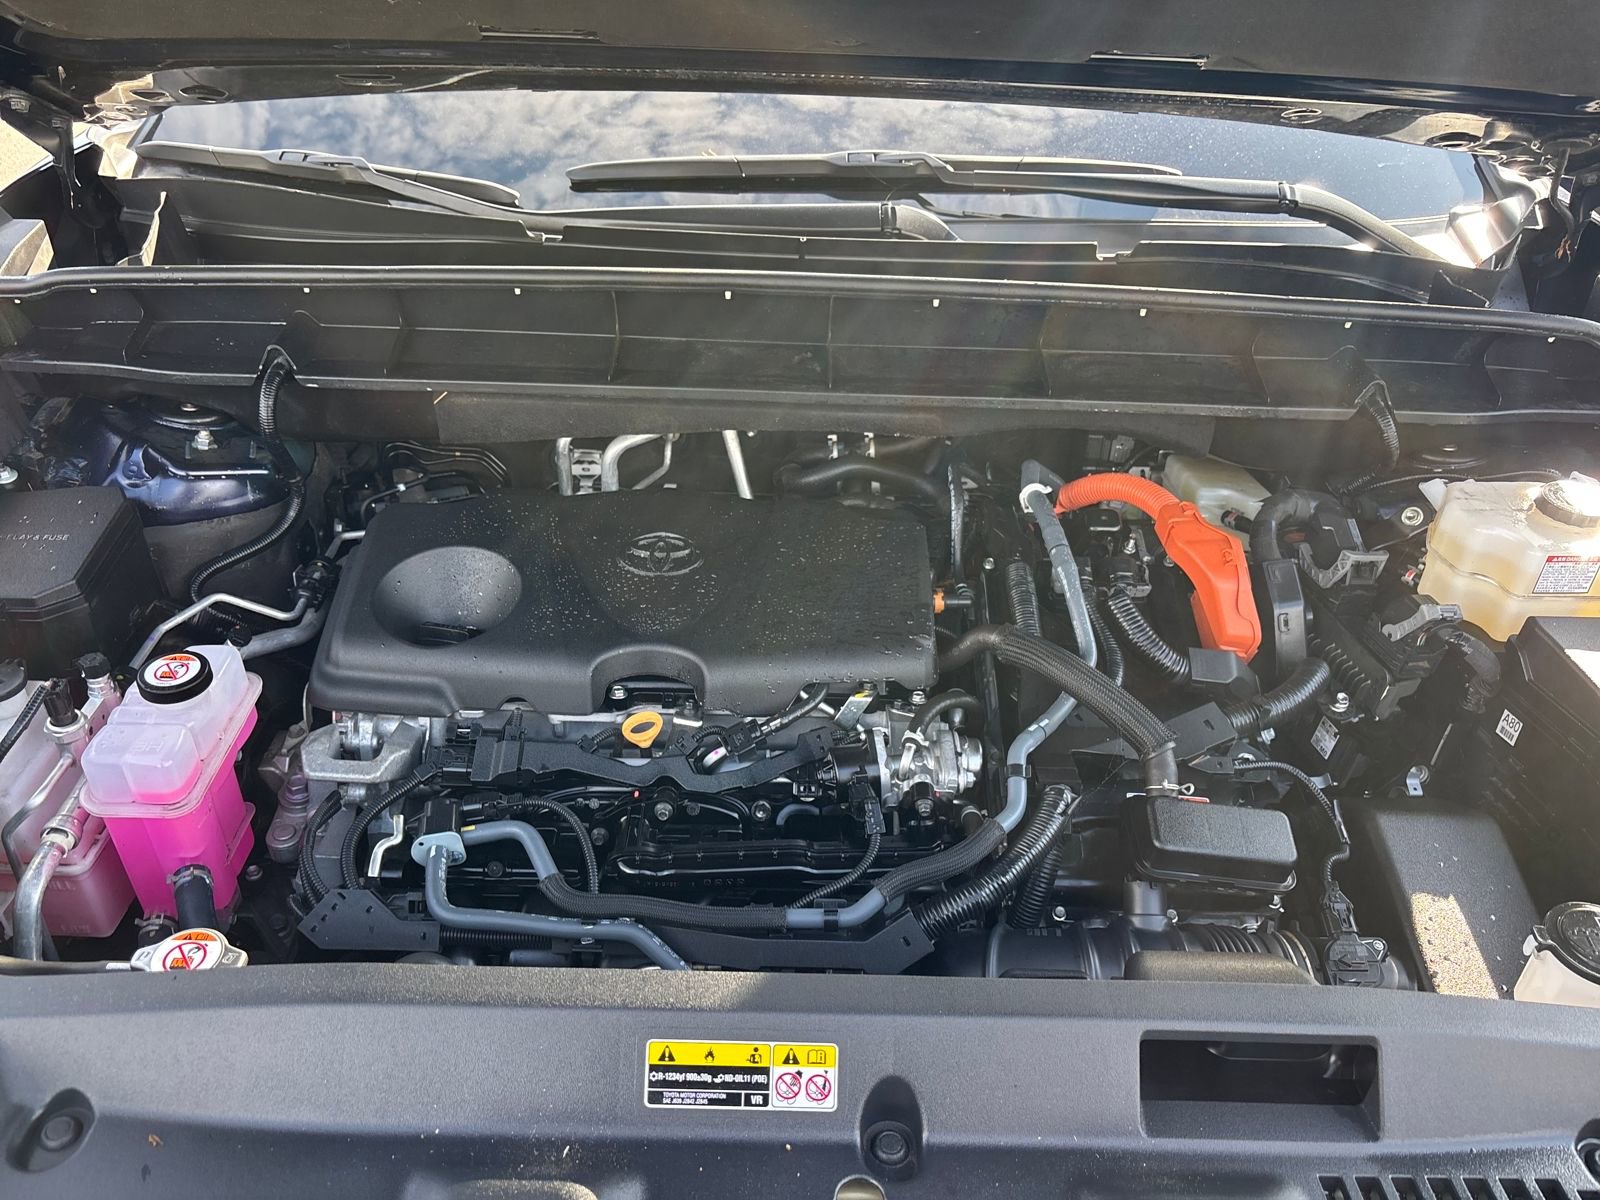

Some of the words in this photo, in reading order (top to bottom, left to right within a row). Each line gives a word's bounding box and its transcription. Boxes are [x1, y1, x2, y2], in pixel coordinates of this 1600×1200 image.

[1502, 713, 1521, 733] A80
[658, 1071, 685, 1082] R-1234yf
[751, 1074, 768, 1085] (POE)
[750, 1094, 764, 1105] VR
